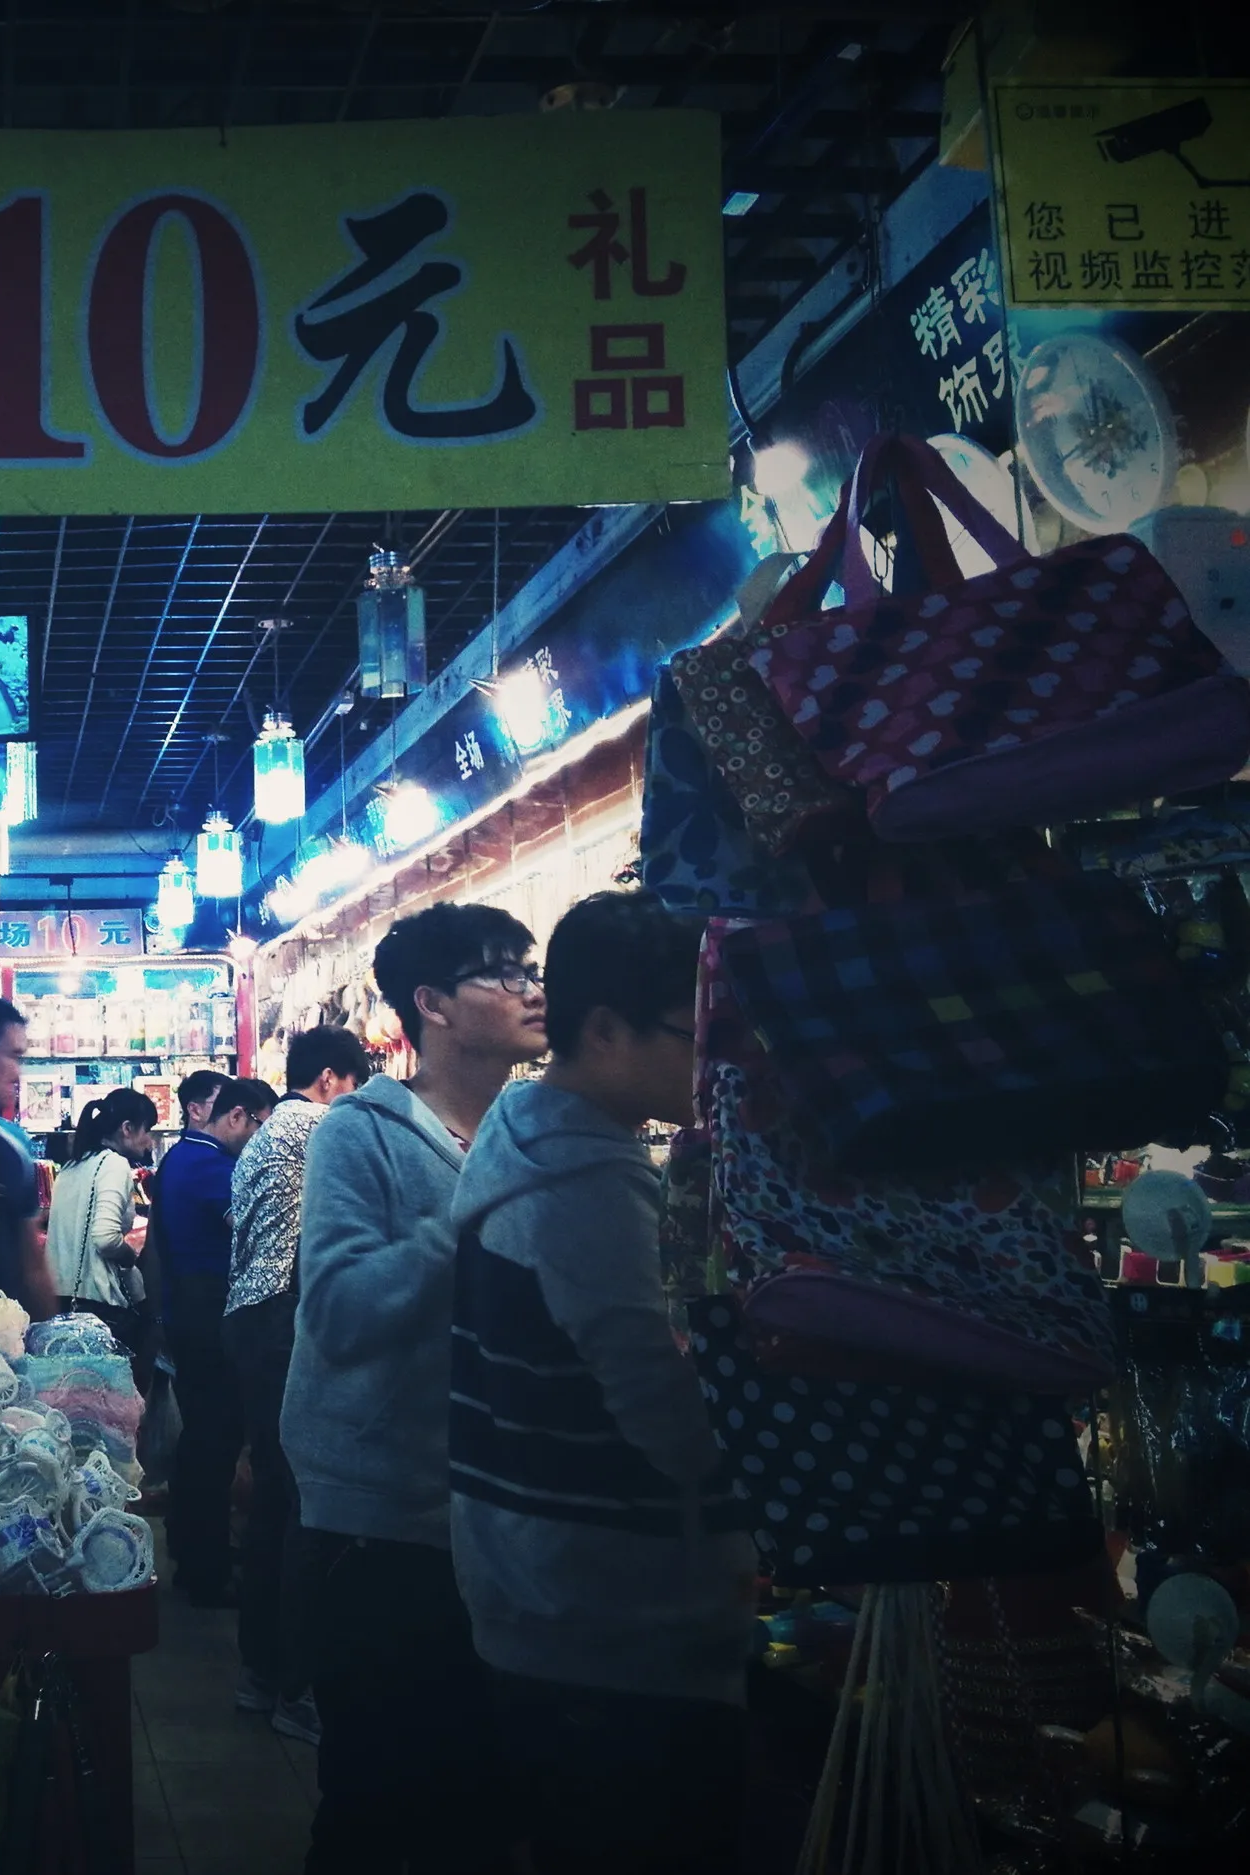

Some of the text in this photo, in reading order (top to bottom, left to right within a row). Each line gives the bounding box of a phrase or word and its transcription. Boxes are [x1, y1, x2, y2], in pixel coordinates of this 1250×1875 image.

[567, 186, 687, 430] 礼品
[910, 248, 1000, 361] 精彩
[455, 730, 485, 781] 全场
